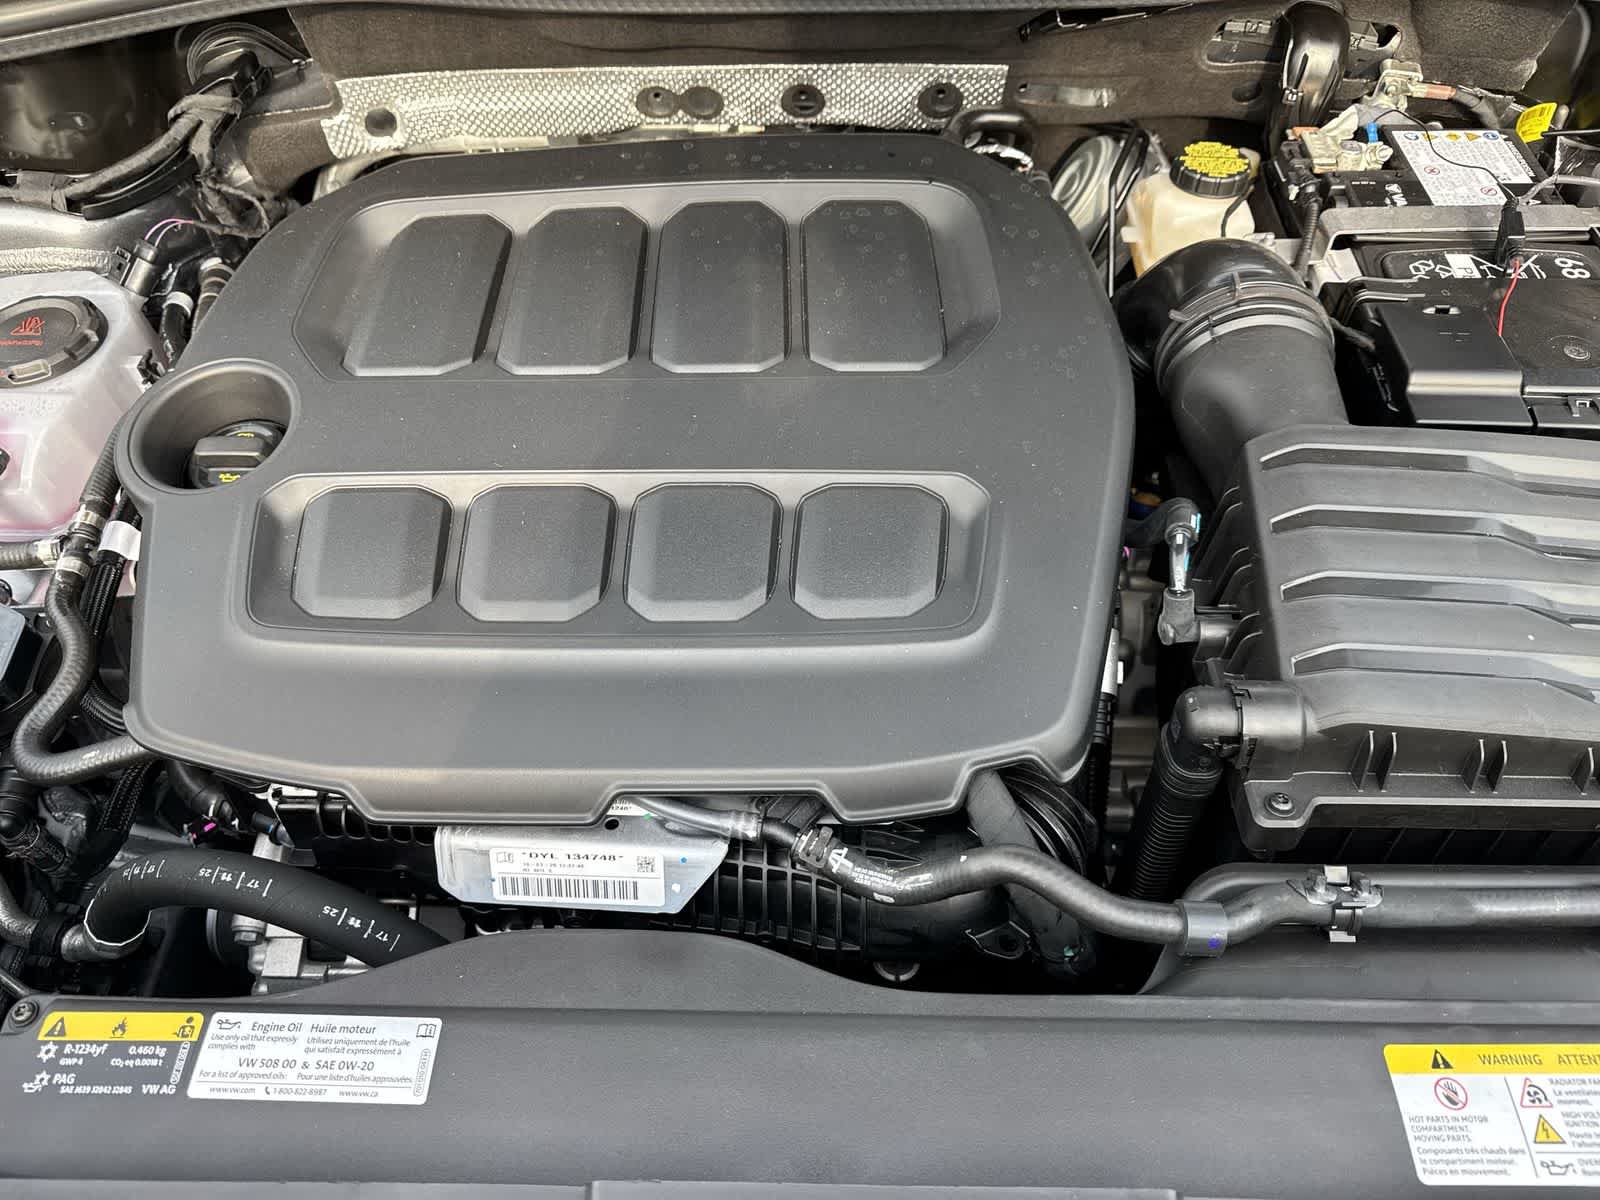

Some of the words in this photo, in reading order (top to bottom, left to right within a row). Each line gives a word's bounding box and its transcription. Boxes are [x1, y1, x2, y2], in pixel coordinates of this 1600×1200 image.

[251, 1021, 285, 1034] Engine
[287, 1022, 303, 1032] Oil
[310, 1023, 338, 1034] Huile
[338, 1025, 376, 1034] moteur
[225, 1034, 239, 1042] only
[266, 1035, 297, 1044] expressly
[307, 1036, 332, 1044] Utilisez
[334, 1038, 378, 1047] uniquement
[63, 1043, 109, 1057] R-1234yf
[155, 1045, 167, 1057] kg
[208, 1043, 238, 1051] complies
[304, 1046, 316, 1054] qui
[317, 1046, 345, 1054] satisfait
[238, 1058, 257, 1068] VW
[259, 1058, 279, 1068] 508
[281, 1059, 297, 1069] 00
[301, 1061, 310, 1069] &
[315, 1060, 336, 1070] SAE
[337, 1060, 375, 1071] 0W-20
[1478, 1054, 1543, 1066] WARNING
[52, 1073, 76, 1085] PAG
[199, 1070, 211, 1078] For
[218, 1070, 229, 1078] list
[230, 1070, 239, 1078] of
[239, 1071, 272, 1080] approved
[329, 1073, 343, 1081] liste
[141, 1084, 159, 1095] VW
[159, 1085, 177, 1095] AG
[1408, 1115, 1424, 1123] HOT
[1425, 1115, 1450, 1123] PARTS
[1451, 1115, 1460, 1123] IN
[1461, 1115, 1488, 1123] MOTOR
[1414, 1134, 1446, 1142] MOVING
[1417, 1146, 1464, 1156] Composants
[1480, 1146, 1506, 1155] chauds
[1428, 1158, 1485, 1167] compartiment
